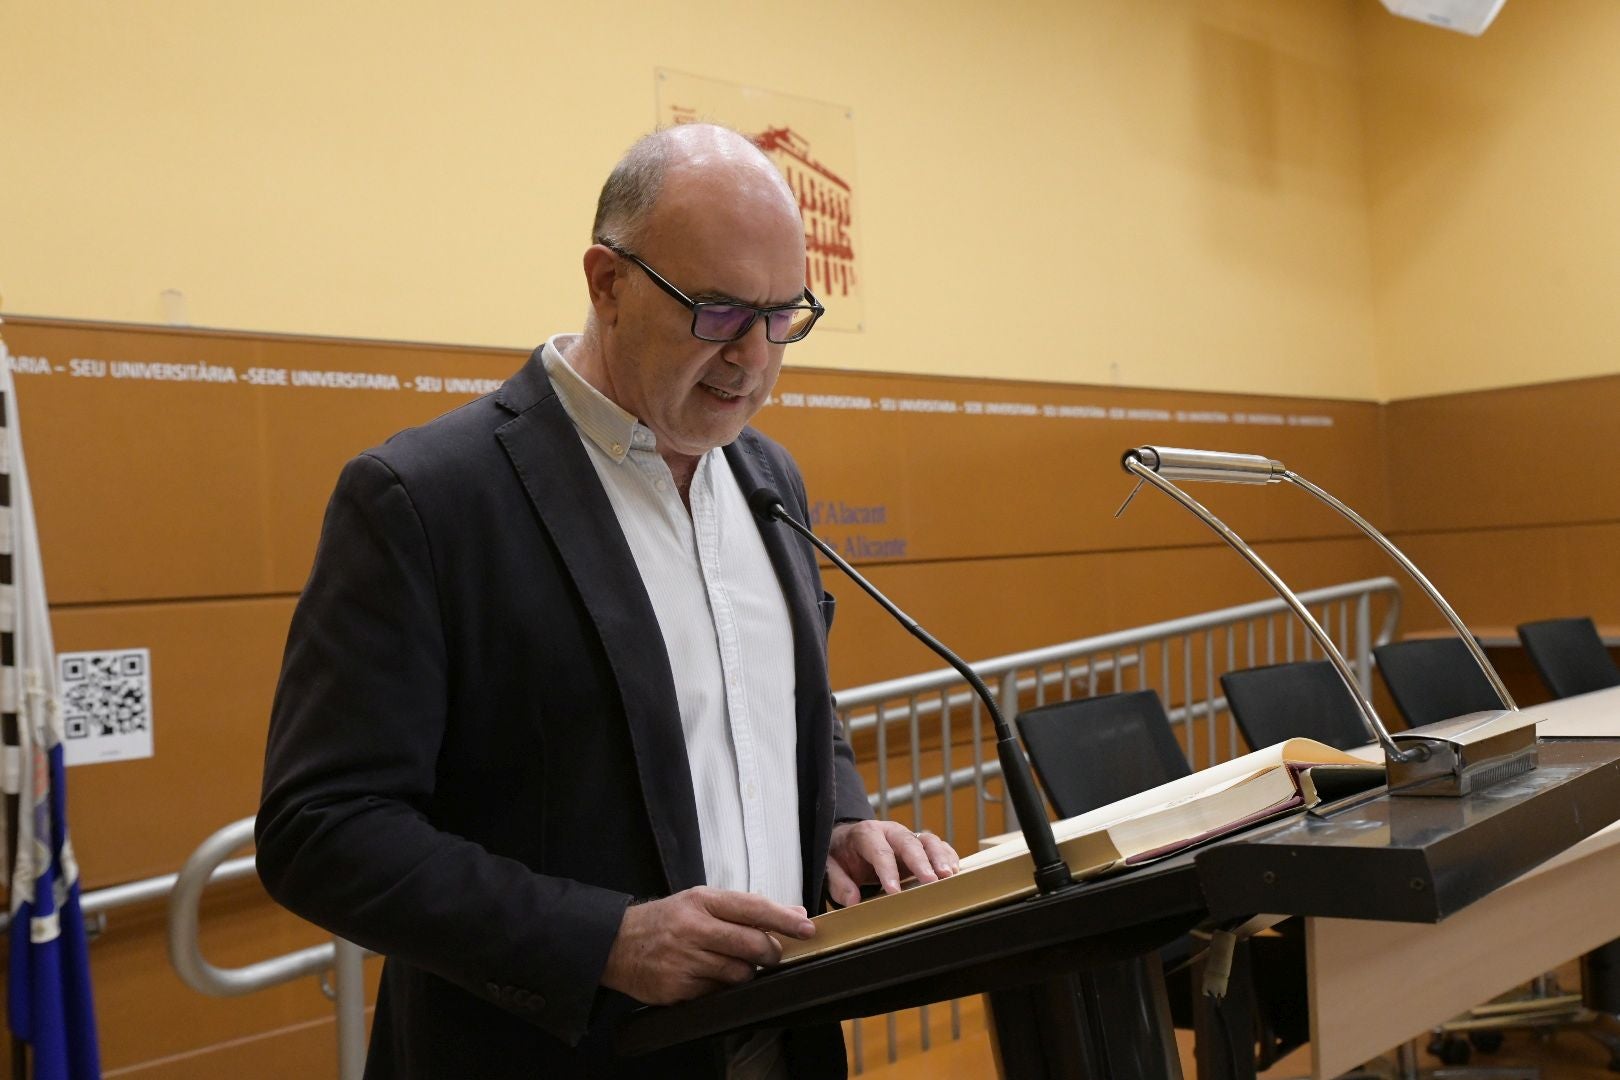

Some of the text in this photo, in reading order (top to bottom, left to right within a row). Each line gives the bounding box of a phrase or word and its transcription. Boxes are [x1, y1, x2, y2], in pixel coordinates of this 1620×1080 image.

[69, 359, 107, 377] SEU
[110, 362, 237, 382] UNIVERSITÀRIA
[291, 371, 400, 390] UNIVERSITARIA
[414, 376, 442, 392] SEU
[780, 393, 804, 407] SEDE
[810, 501, 886, 524] d'Alacant
[844, 536, 906, 558] Alicante
